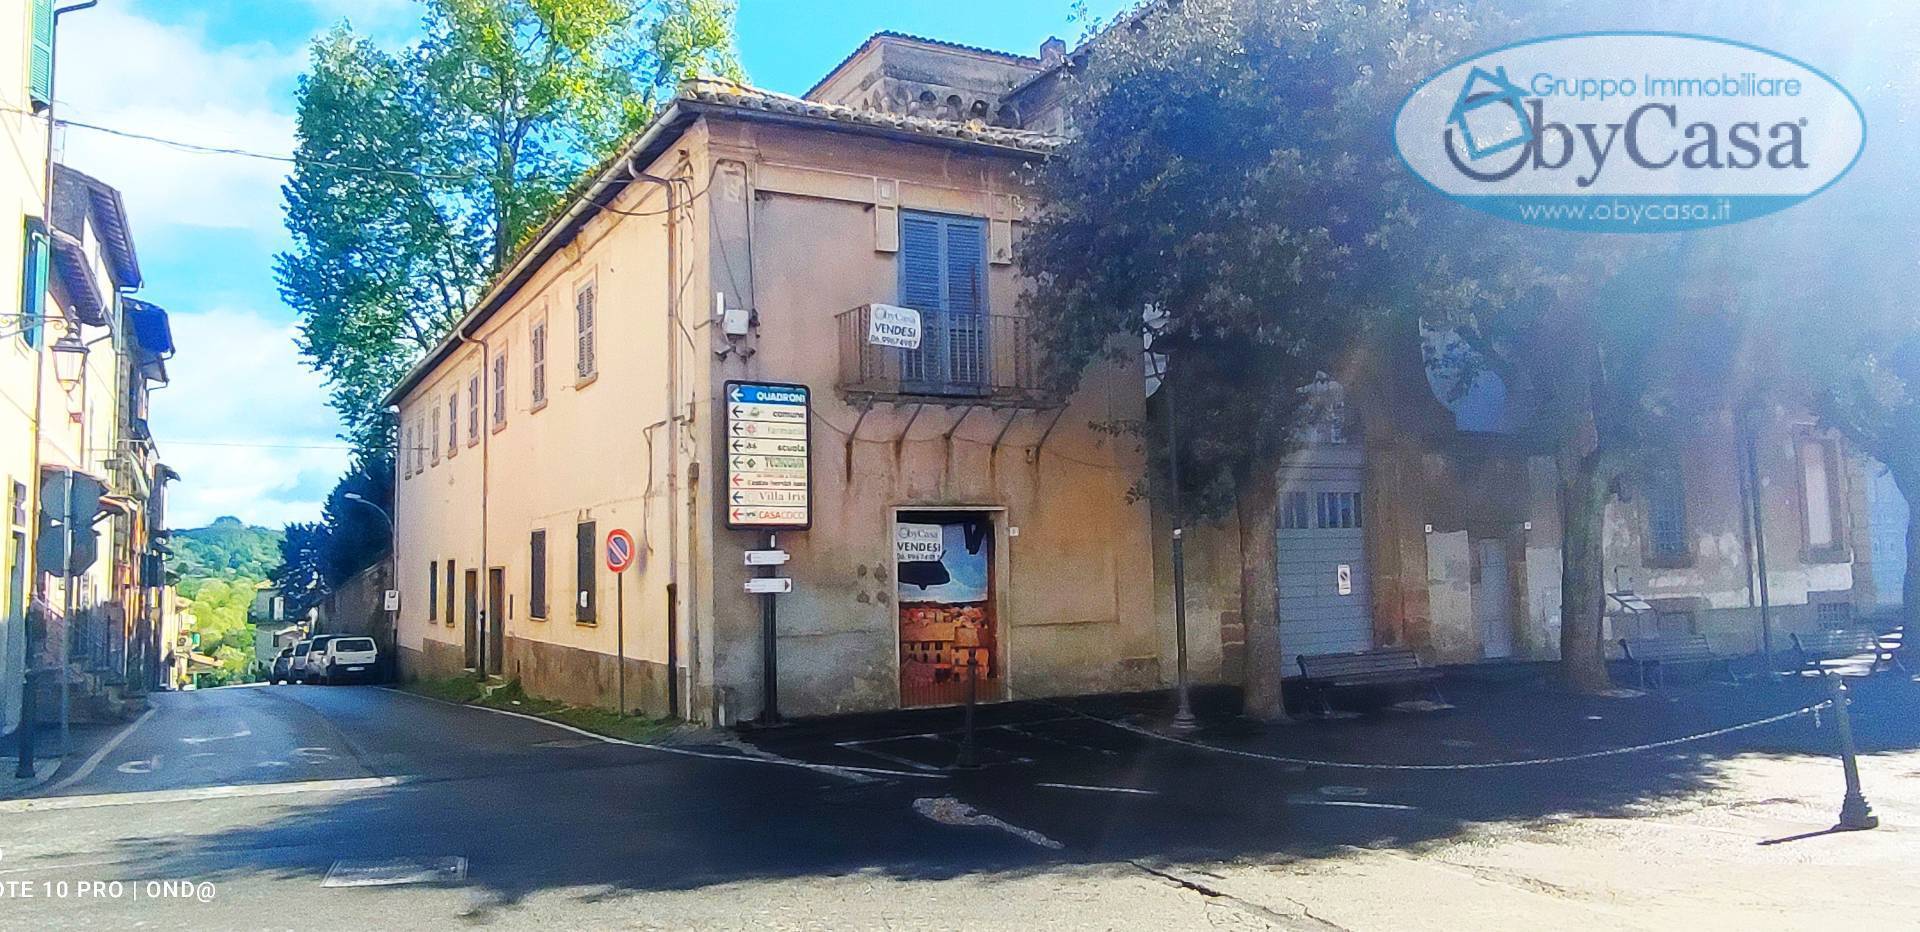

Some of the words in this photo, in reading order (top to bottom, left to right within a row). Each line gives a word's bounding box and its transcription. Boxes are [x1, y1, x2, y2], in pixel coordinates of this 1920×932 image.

[875, 322, 916, 337] VENDESI
[756, 391, 806, 402] QUADRONI
[777, 444, 805, 452] scuola
[759, 491, 784, 501] Villa
[788, 492, 806, 501] Iris
[896, 542, 941, 552] VENDESI
